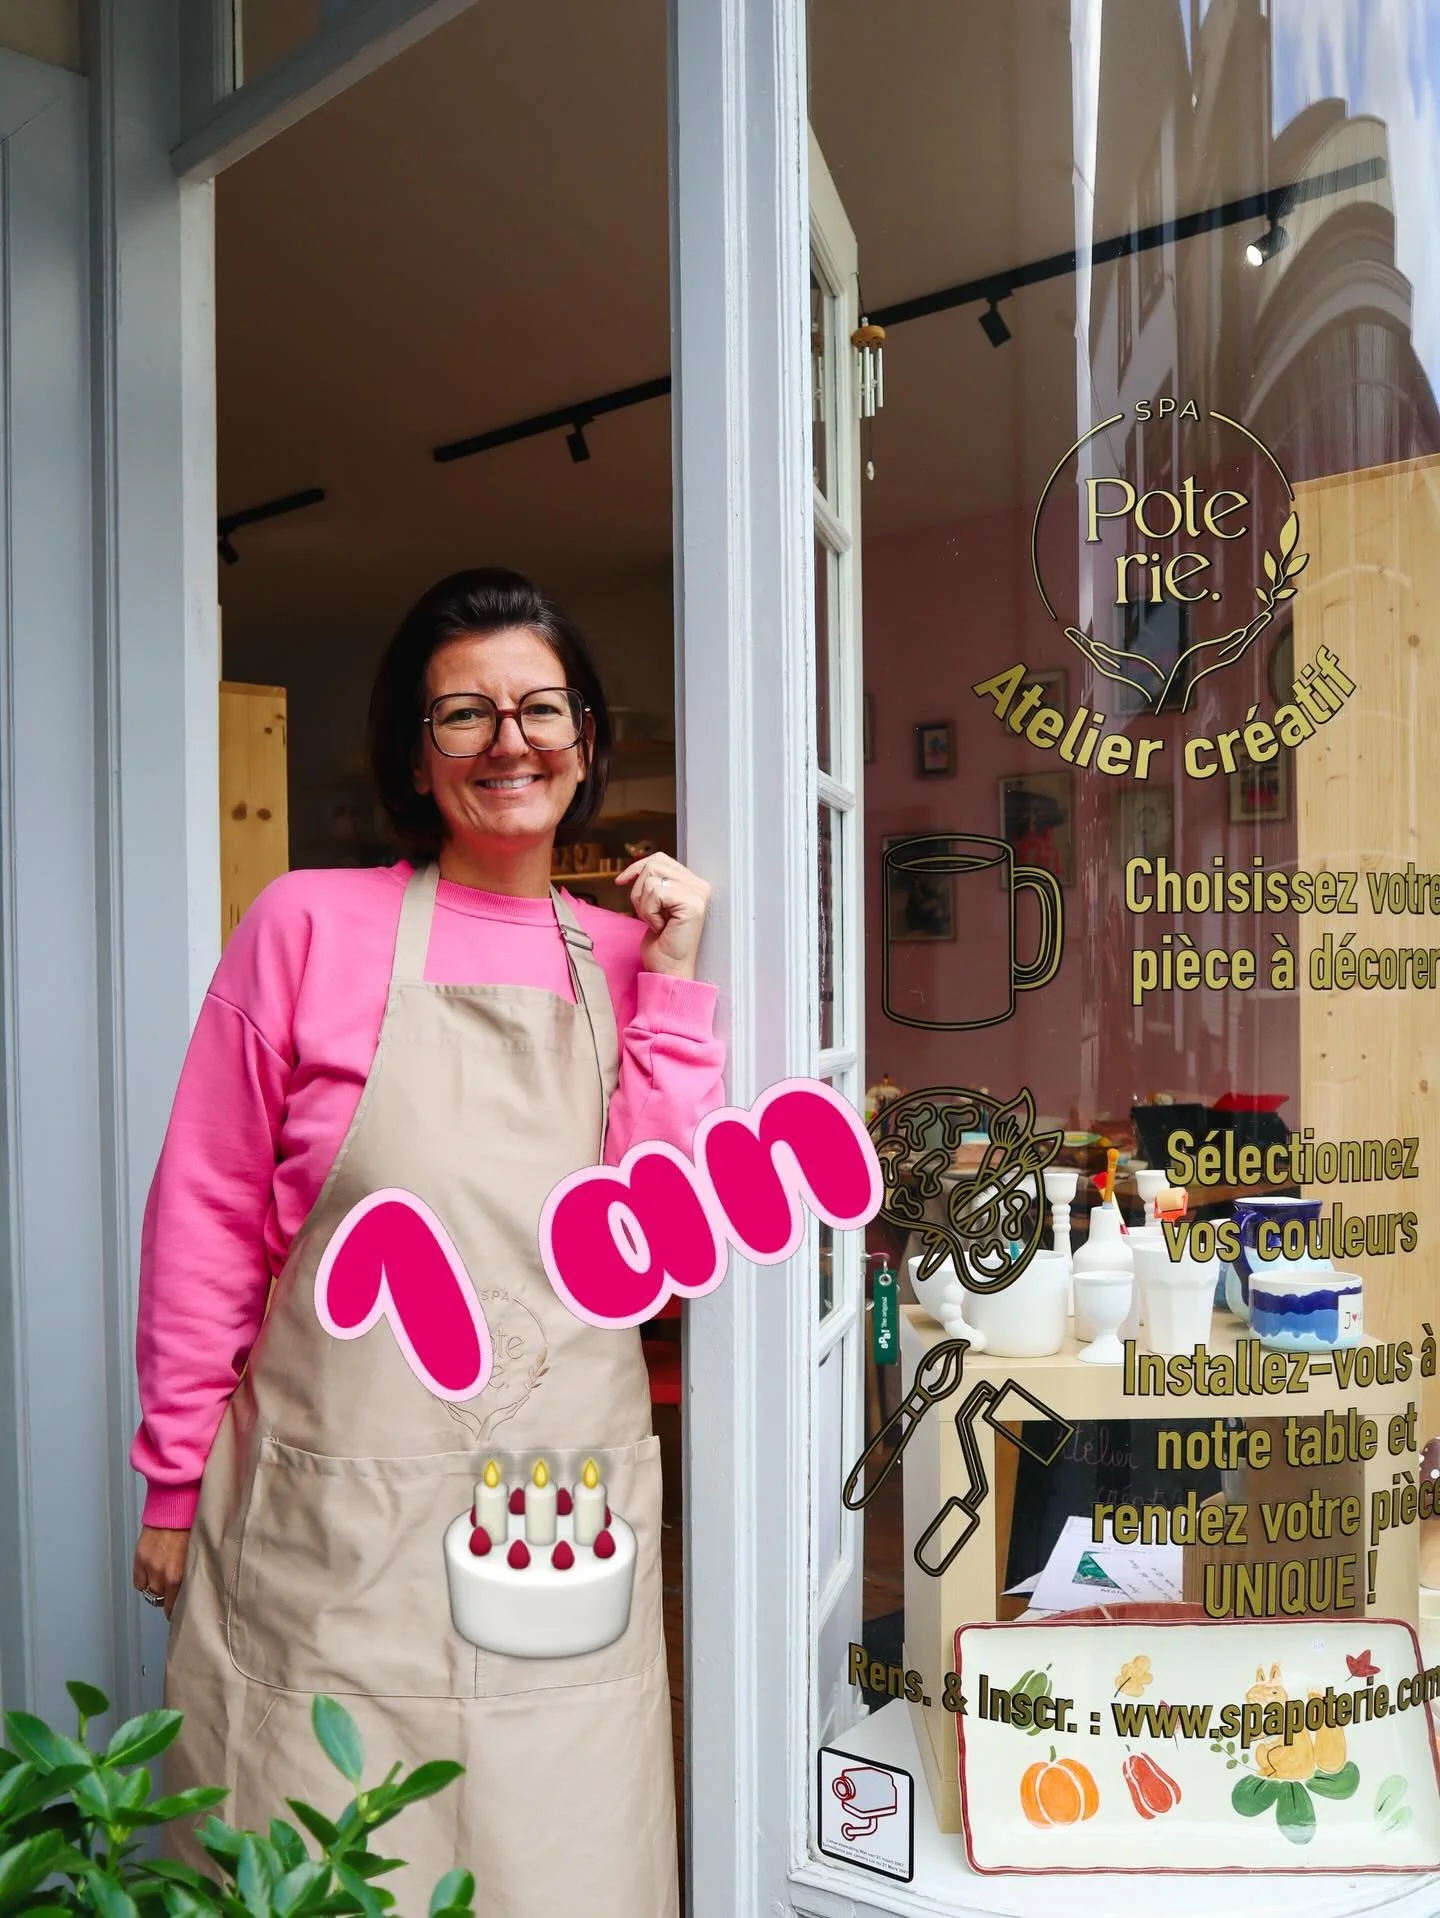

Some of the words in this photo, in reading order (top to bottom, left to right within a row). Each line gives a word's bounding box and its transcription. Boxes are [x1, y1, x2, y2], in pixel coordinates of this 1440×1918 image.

[1135, 398, 1199, 421] SPA
[1085, 475, 1249, 543] Pote
[1114, 550, 1221, 606] rie.
[972, 662, 1164, 780] Atelier
[1183, 645, 1357, 780] créatif
[1125, 856, 1358, 914] Choisissez
[1132, 933, 1257, 1006] pièce
[1270, 933, 1295, 990] à
[1309, 933, 1440, 990] décorer
[1165, 1128, 1420, 1187] Sélectionnez
[1161, 1219, 1242, 1263] vos
[1257, 1202, 1418, 1261] couleurs
[480, 1289, 509, 1301] SPA
[1123, 1340, 1413, 1396] Installez-vous
[1420, 1323, 1437, 1377] à
[1156, 1419, 1271, 1471] notre
[1283, 1408, 1379, 1468] table
[1388, 1402, 1418, 1455] et
[1091, 1489, 1248, 1545] rendez
[1260, 1489, 1361, 1543] votre
[1203, 1553, 1357, 1619] UNIQUE
[1366, 1550, 1378, 1605] !
[848, 1641, 932, 1707] Rens.
[942, 1671, 968, 1716] &
[978, 1674, 1078, 1733] Inscr.
[1111, 1664, 1440, 1749] www.spapoterie.com
